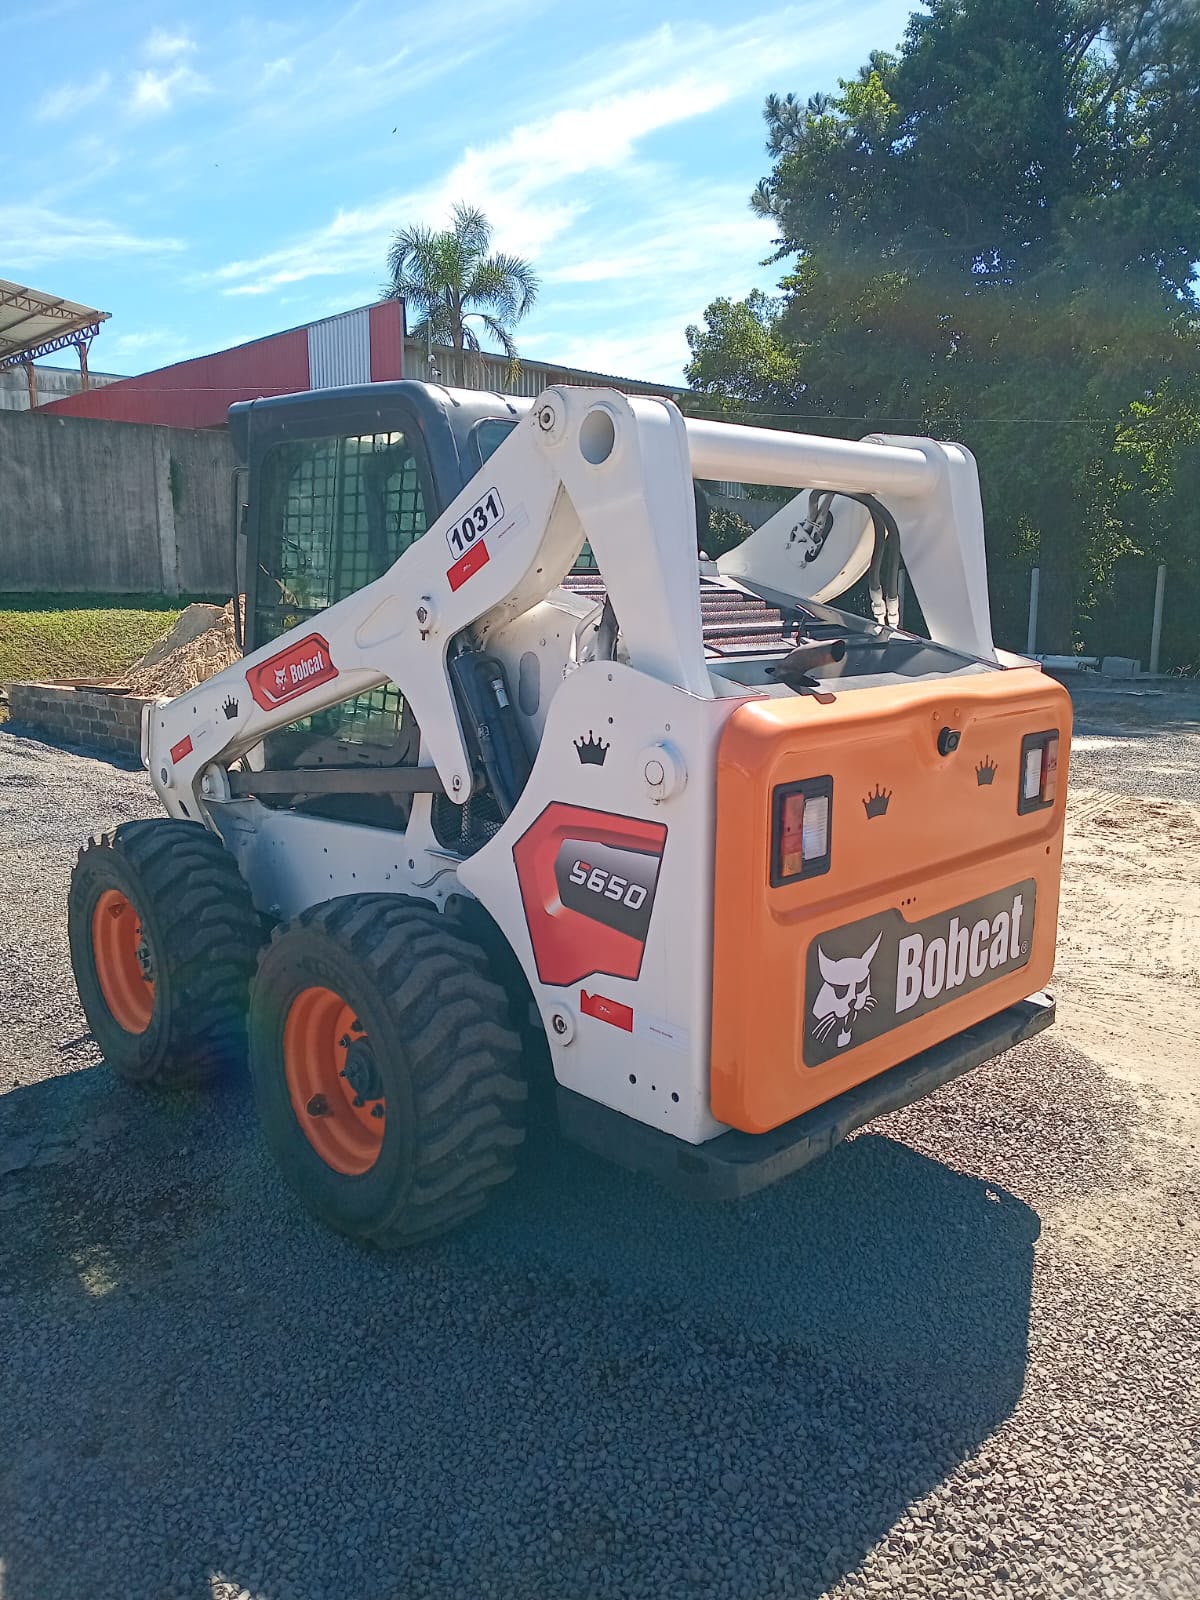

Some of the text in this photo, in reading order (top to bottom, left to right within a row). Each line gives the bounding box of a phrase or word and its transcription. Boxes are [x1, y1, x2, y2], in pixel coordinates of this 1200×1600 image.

[451, 494, 499, 551] 1031
[289, 651, 325, 684] Bobcat
[569, 860, 648, 910] S650
[895, 894, 1024, 1014] Bobcat
